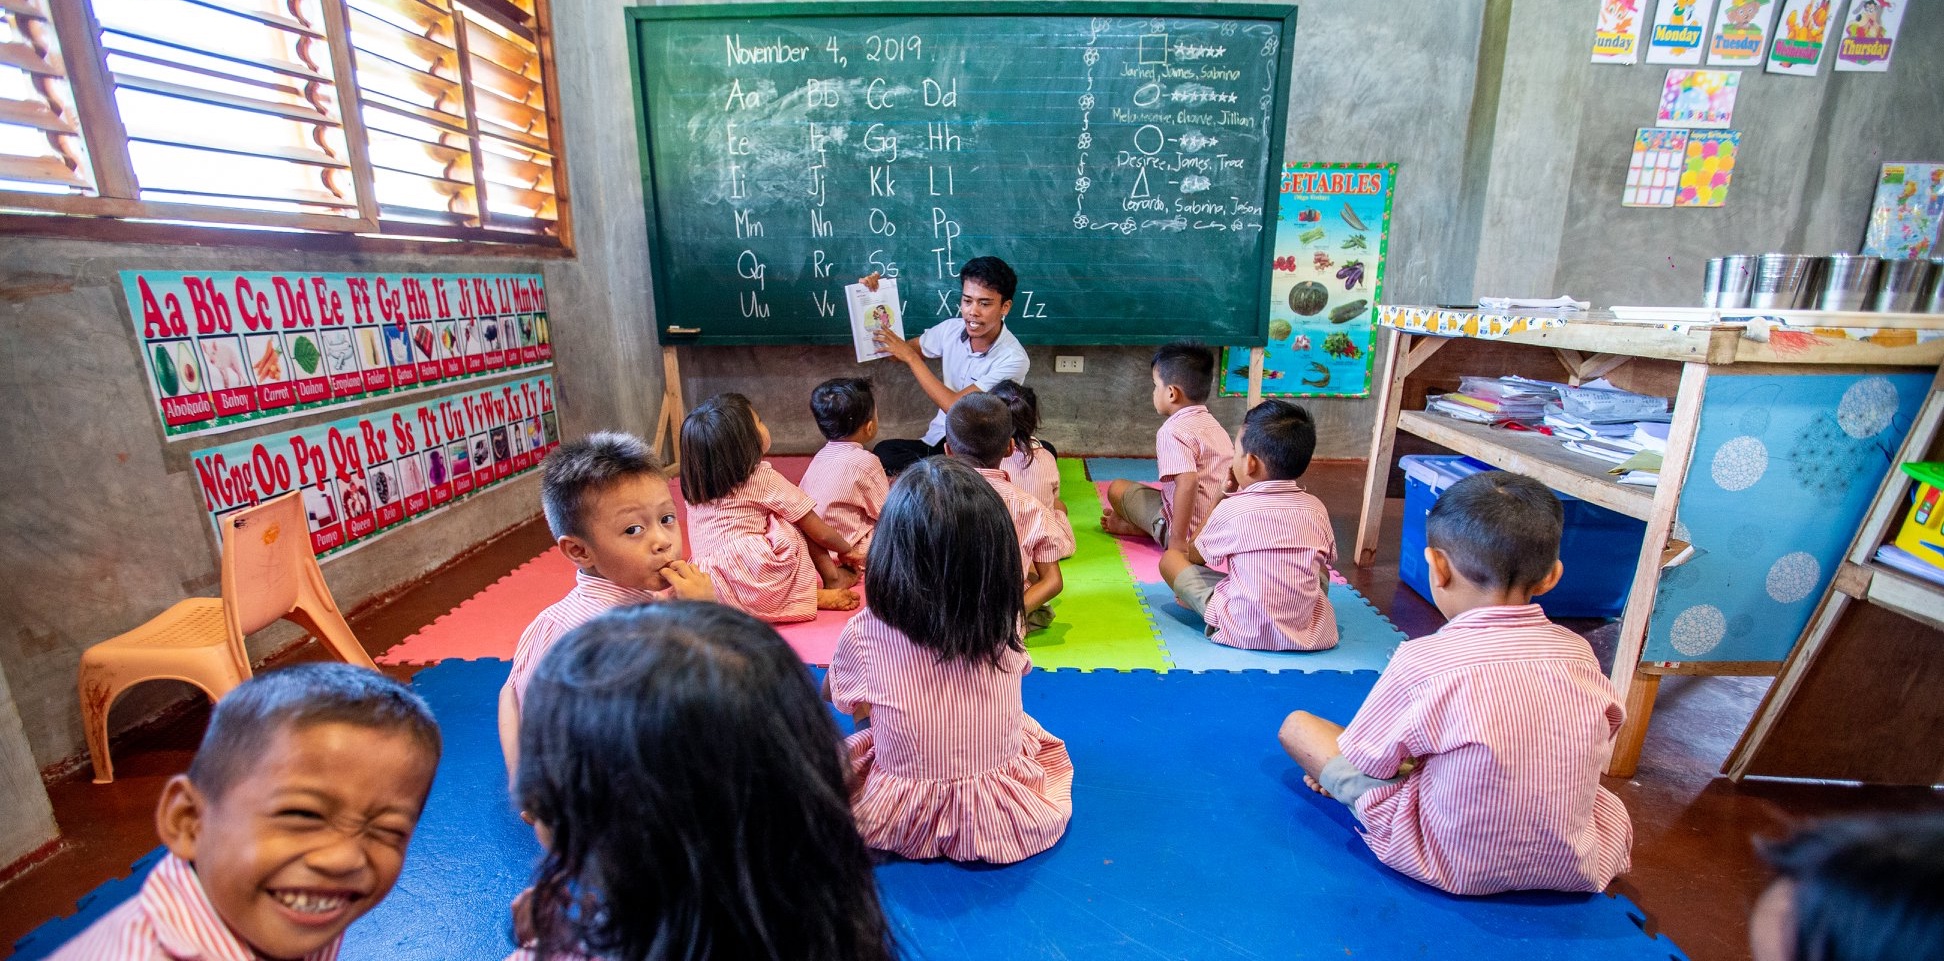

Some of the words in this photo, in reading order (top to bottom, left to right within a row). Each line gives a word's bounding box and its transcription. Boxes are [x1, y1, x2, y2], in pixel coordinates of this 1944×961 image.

[726, 34, 809, 67] November
[826, 36, 847, 68] 4,
[866, 35, 922, 61] 2019
[1654, 26, 1700, 45] Monday
[1715, 35, 1760, 53] Tuesday
[1842, 39, 1889, 58] Thursday
[1200, 65, 1241, 80] Sabrina
[725, 78, 760, 111] Aa
[807, 78, 839, 107] Bb
[866, 78, 894, 110] Cc
[922, 77, 957, 108] Dd
[727, 123, 750, 155] Ee
[864, 123, 897, 162] Gg
[928, 121, 961, 151] Hh
[730, 165, 746, 199] Ii
[807, 164, 826, 207] Jj
[870, 165, 896, 196] Kk
[1280, 172, 1382, 195] GETABLES
[1231, 197, 1262, 215] Jason
[734, 208, 763, 239] Mm
[811, 208, 833, 238] Nn
[869, 208, 896, 237] Oo
[932, 207, 960, 251] Pp
[737, 250, 766, 291] Qq
[814, 250, 834, 278] Rr
[868, 250, 899, 278] Ss
[931, 246, 960, 279] Tt
[137, 275, 188, 338] Aa
[183, 276, 232, 334] Bb
[235, 276, 273, 331] Cc
[272, 276, 314, 328] Dd
[311, 276, 344, 325] Ee
[346, 277, 374, 324] Ff
[376, 276, 406, 332] Gg
[402, 277, 431, 320] Hh
[432, 277, 451, 318] Ii
[458, 278, 475, 327] Jj
[472, 278, 497, 315] Kk
[496, 278, 511, 313] Ll
[510, 278, 533, 313] Mm
[529, 278, 546, 311] Nn
[741, 290, 770, 318] Uu
[813, 290, 835, 317] Vv
[1021, 291, 1047, 318] Zz
[167, 394, 211, 418] Abokado
[221, 389, 249, 410] Baboy
[264, 385, 289, 402] Carrot
[299, 380, 324, 396] Dahon
[366, 370, 385, 386] Folder
[195, 453, 259, 511] NGng
[252, 443, 291, 496] Oo
[289, 435, 326, 491] Pp
[328, 426, 365, 483] Qq
[359, 419, 388, 465] Rr
[392, 412, 416, 455] Ss
[417, 406, 440, 447] Tt
[440, 401, 465, 440] Uu
[462, 395, 483, 433] Vv
[480, 391, 505, 429] Ww
[503, 387, 523, 422] Xx
[520, 382, 541, 433] Yy
[538, 379, 553, 412] Zz
[351, 517, 372, 536] Queen
